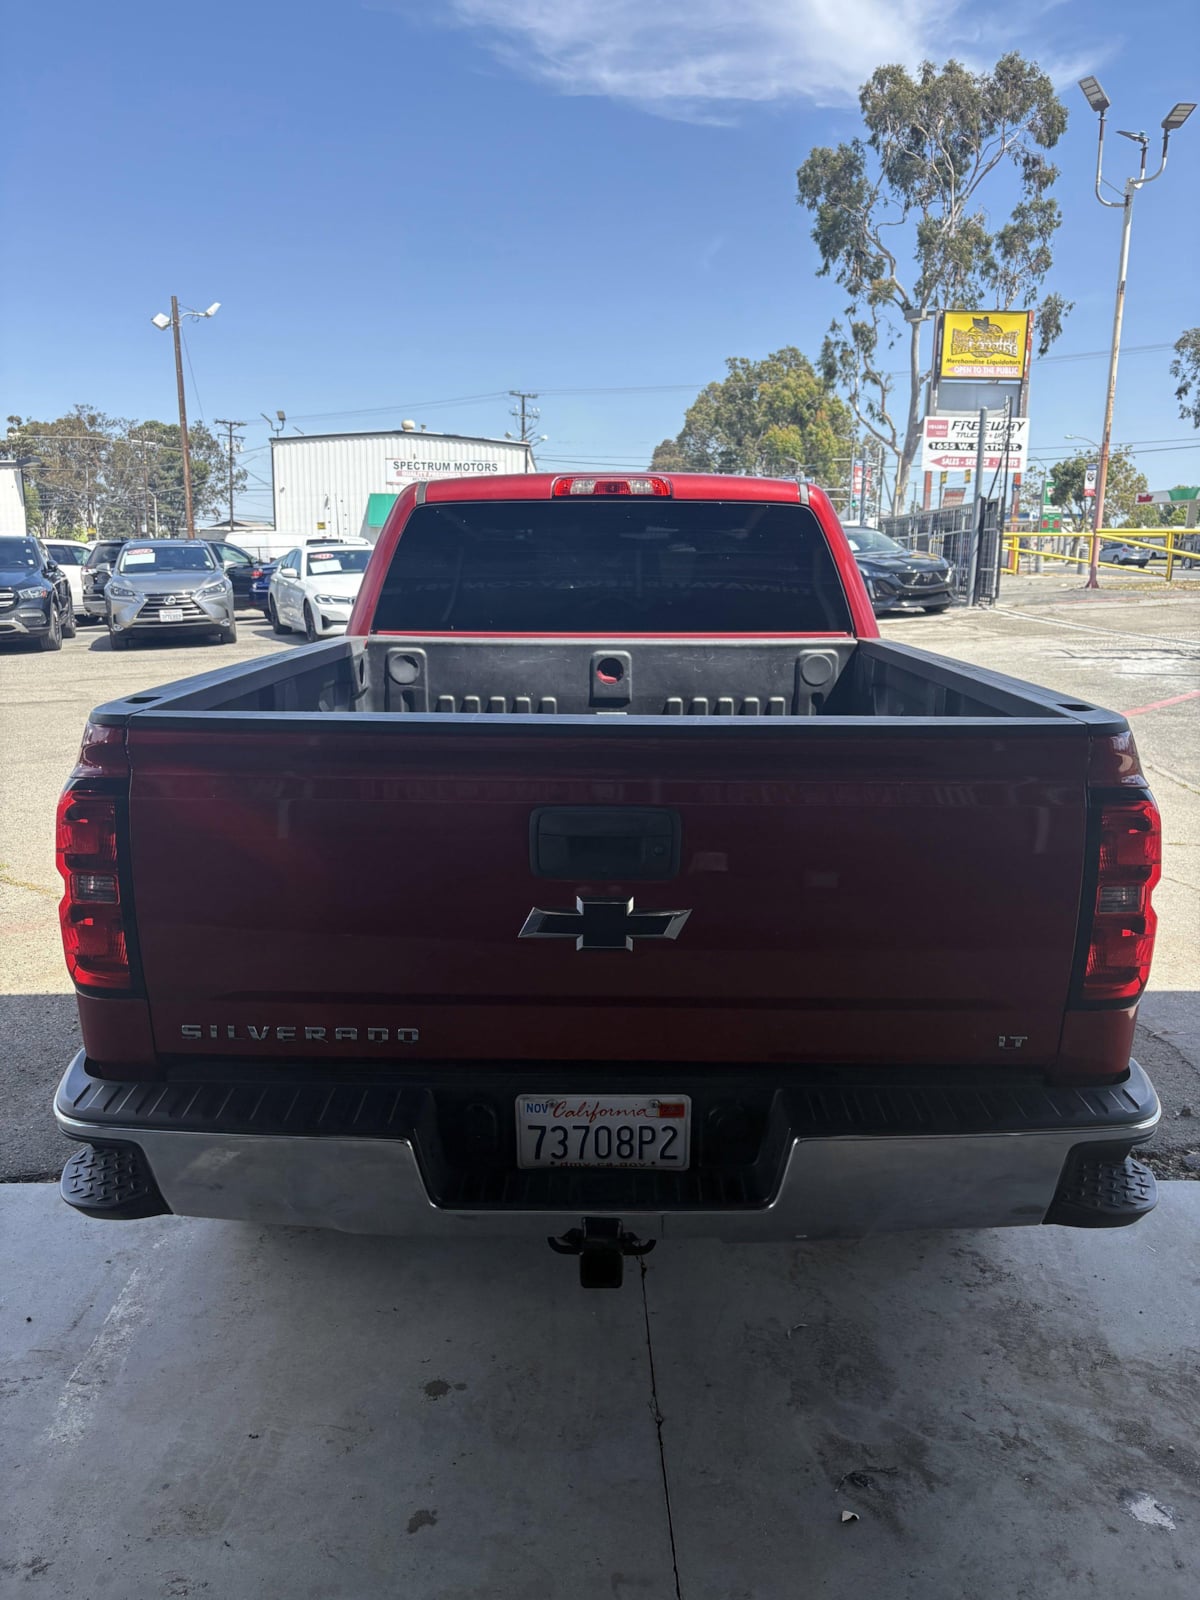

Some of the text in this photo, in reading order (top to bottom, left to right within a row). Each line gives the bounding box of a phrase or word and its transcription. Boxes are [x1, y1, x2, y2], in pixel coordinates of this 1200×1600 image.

[954, 366, 1018, 375] OPEN TO THE PUBLIC
[931, 442, 956, 451] 1655
[957, 443, 971, 451] W.
[973, 443, 1005, 452] SXTH
[393, 461, 498, 472] SPECTRUM MOTORS
[941, 457, 960, 465] SALES
[180, 1024, 420, 1044] SILVERADO
[999, 1036, 1028, 1049] LT
[526, 1103, 549, 1114] NOV
[552, 1100, 656, 1124] California
[527, 1125, 678, 1161] 73708P2
